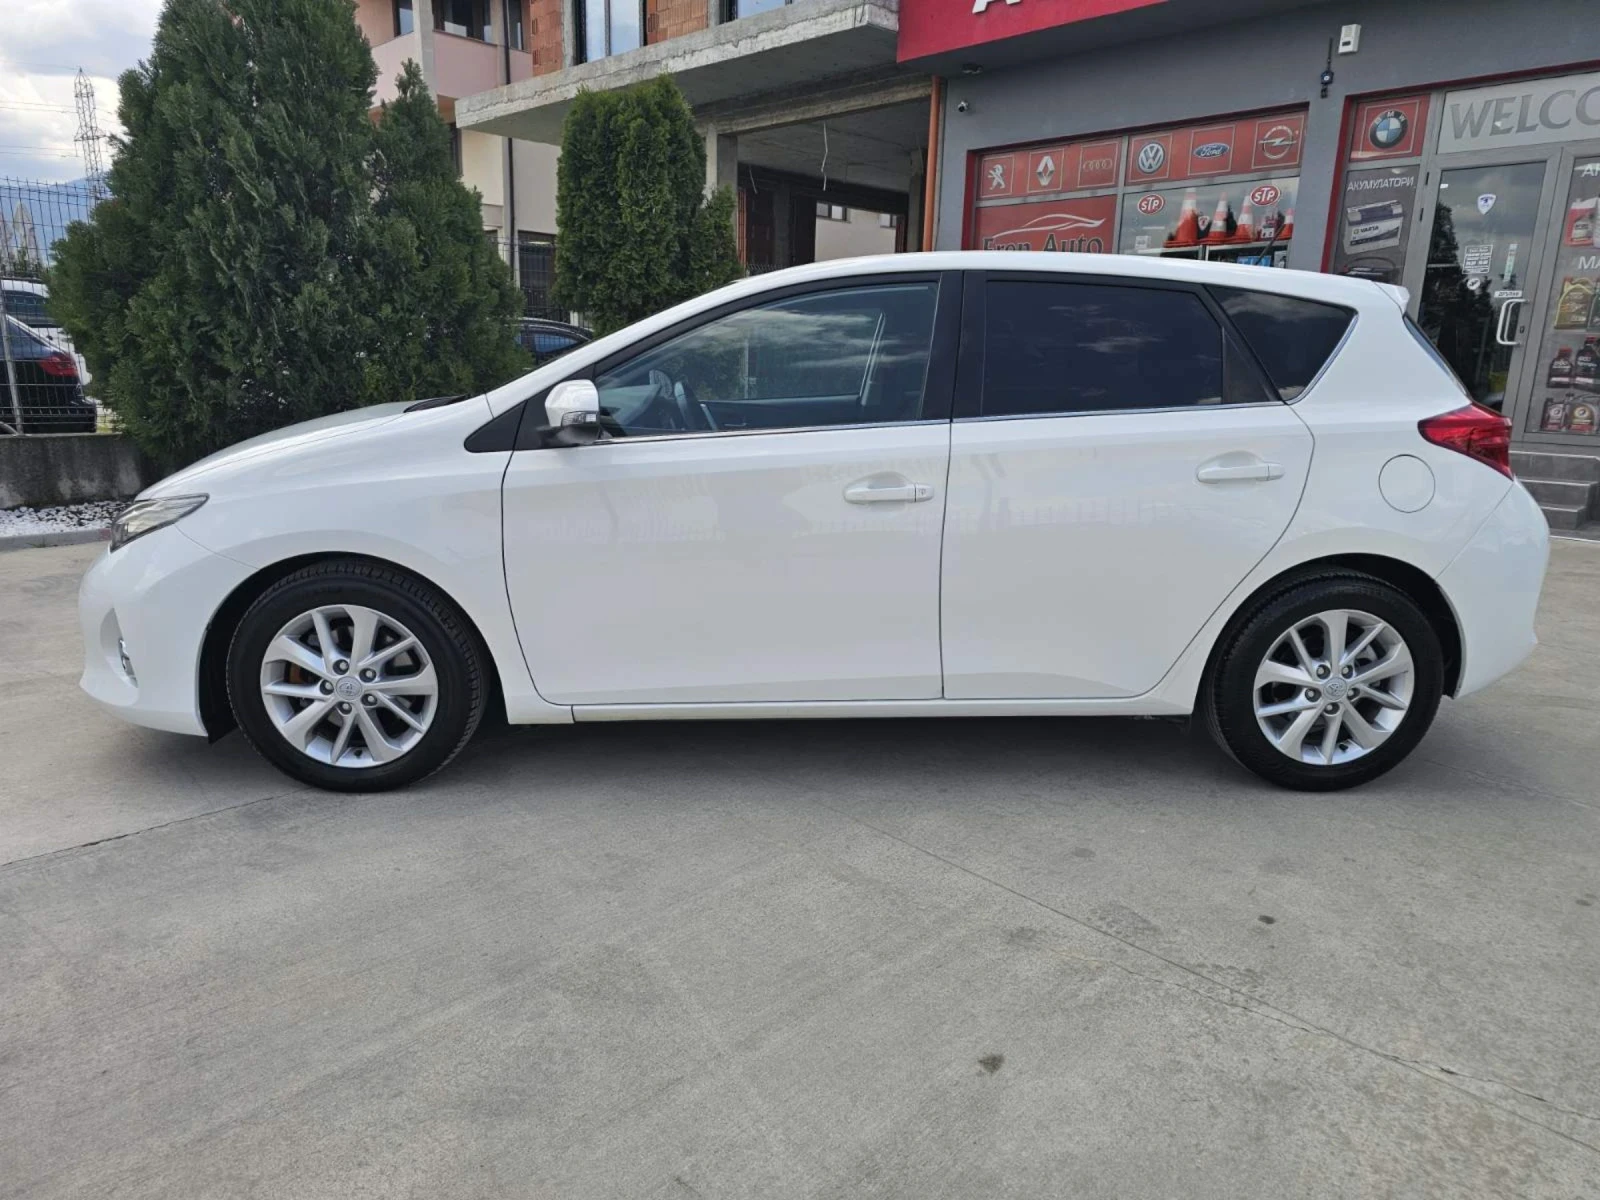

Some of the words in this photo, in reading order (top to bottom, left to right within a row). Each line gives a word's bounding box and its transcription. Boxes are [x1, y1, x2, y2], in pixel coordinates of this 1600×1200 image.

[1200, 146, 1222, 157] Ford
[1347, 176, 1414, 191] АКУМУЛАТОРИ
[1254, 187, 1275, 202] STP
[1142, 196, 1159, 211] STP
[1043, 233, 1104, 253] Auto
